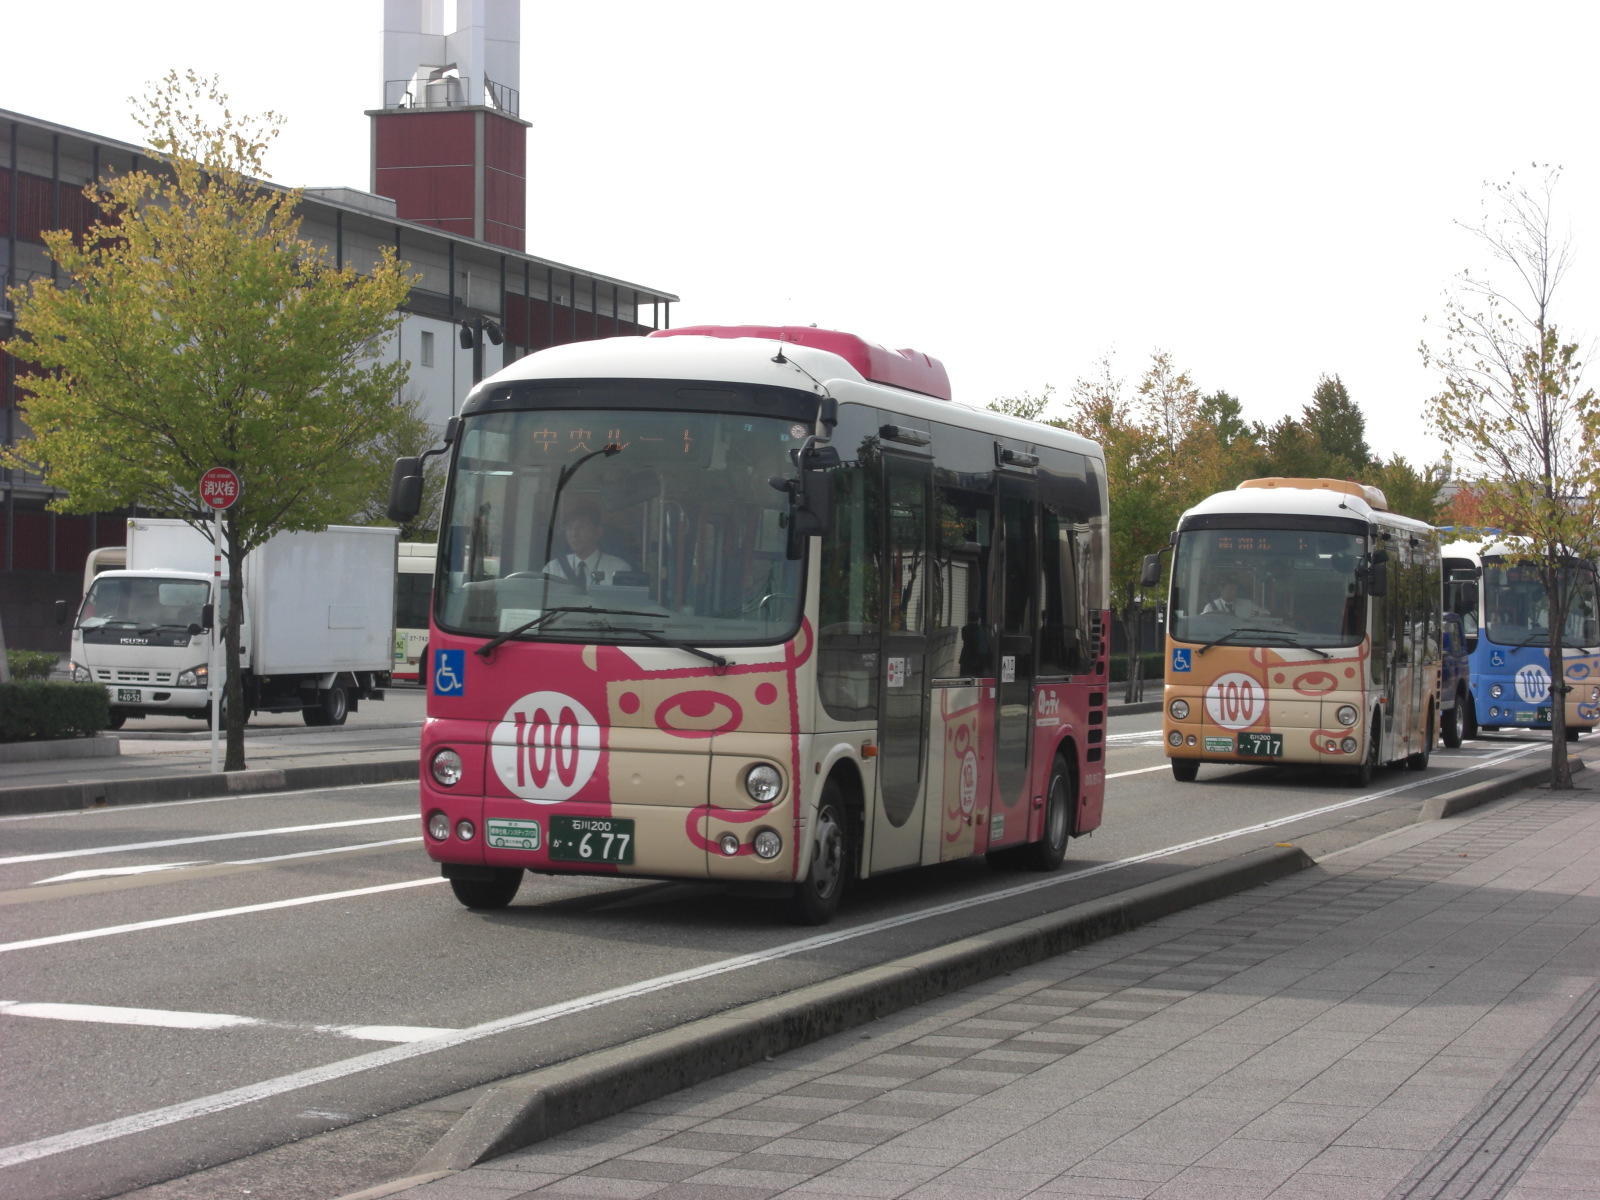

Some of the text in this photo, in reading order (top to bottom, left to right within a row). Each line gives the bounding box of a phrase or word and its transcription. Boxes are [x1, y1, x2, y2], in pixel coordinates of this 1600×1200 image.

[533, 428, 695, 453] 中央ルート
[204, 480, 236, 496] 消火栓
[1521, 669, 1546, 698] 100
[1217, 680, 1254, 722] 100
[514, 706, 579, 788] 100
[572, 819, 612, 832] 石川200
